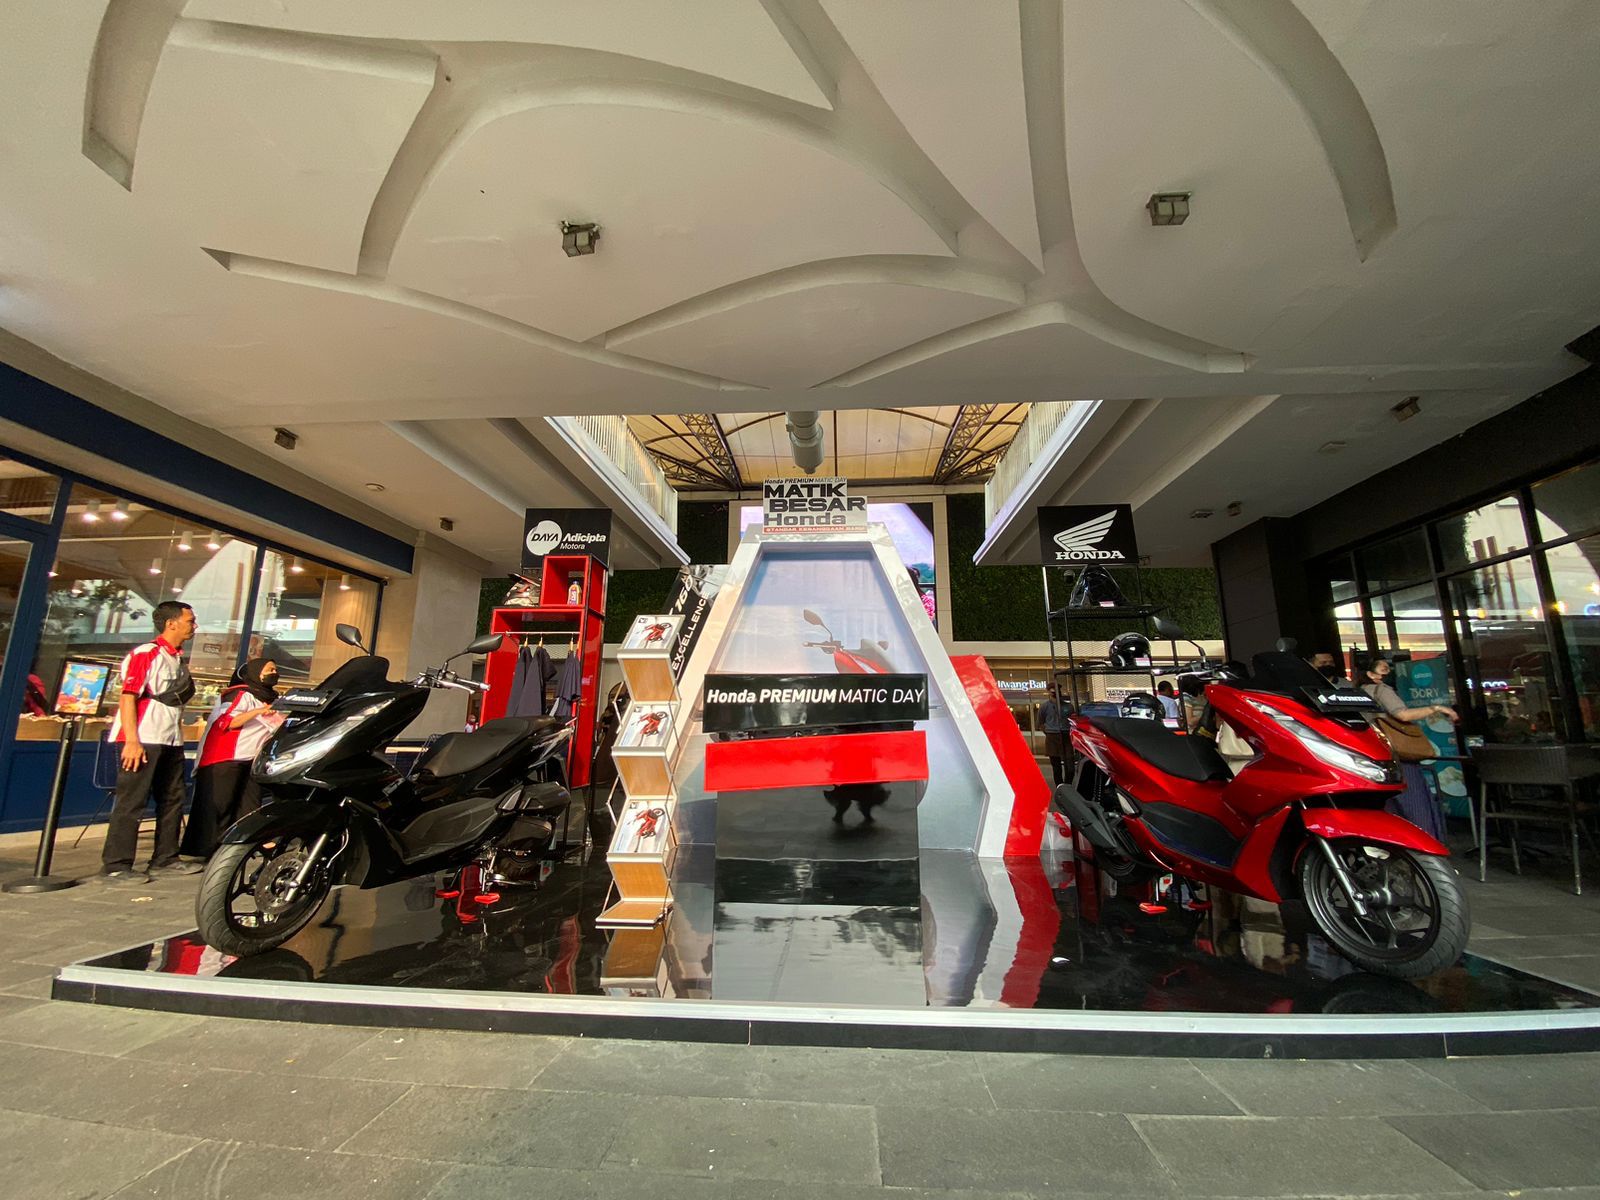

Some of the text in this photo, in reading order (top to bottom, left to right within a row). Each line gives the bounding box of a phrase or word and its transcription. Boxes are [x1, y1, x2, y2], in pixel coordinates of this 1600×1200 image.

[764, 483, 846, 498] MATIK
[769, 497, 866, 512] BESAR
[764, 513, 846, 526] Honda
[531, 532, 607, 544] DAYA Adicipta
[1055, 551, 1126, 560] HONDA
[671, 591, 710, 671] EXCELLENCE
[706, 688, 924, 704] Honda PREMIUM MATIC DAY
